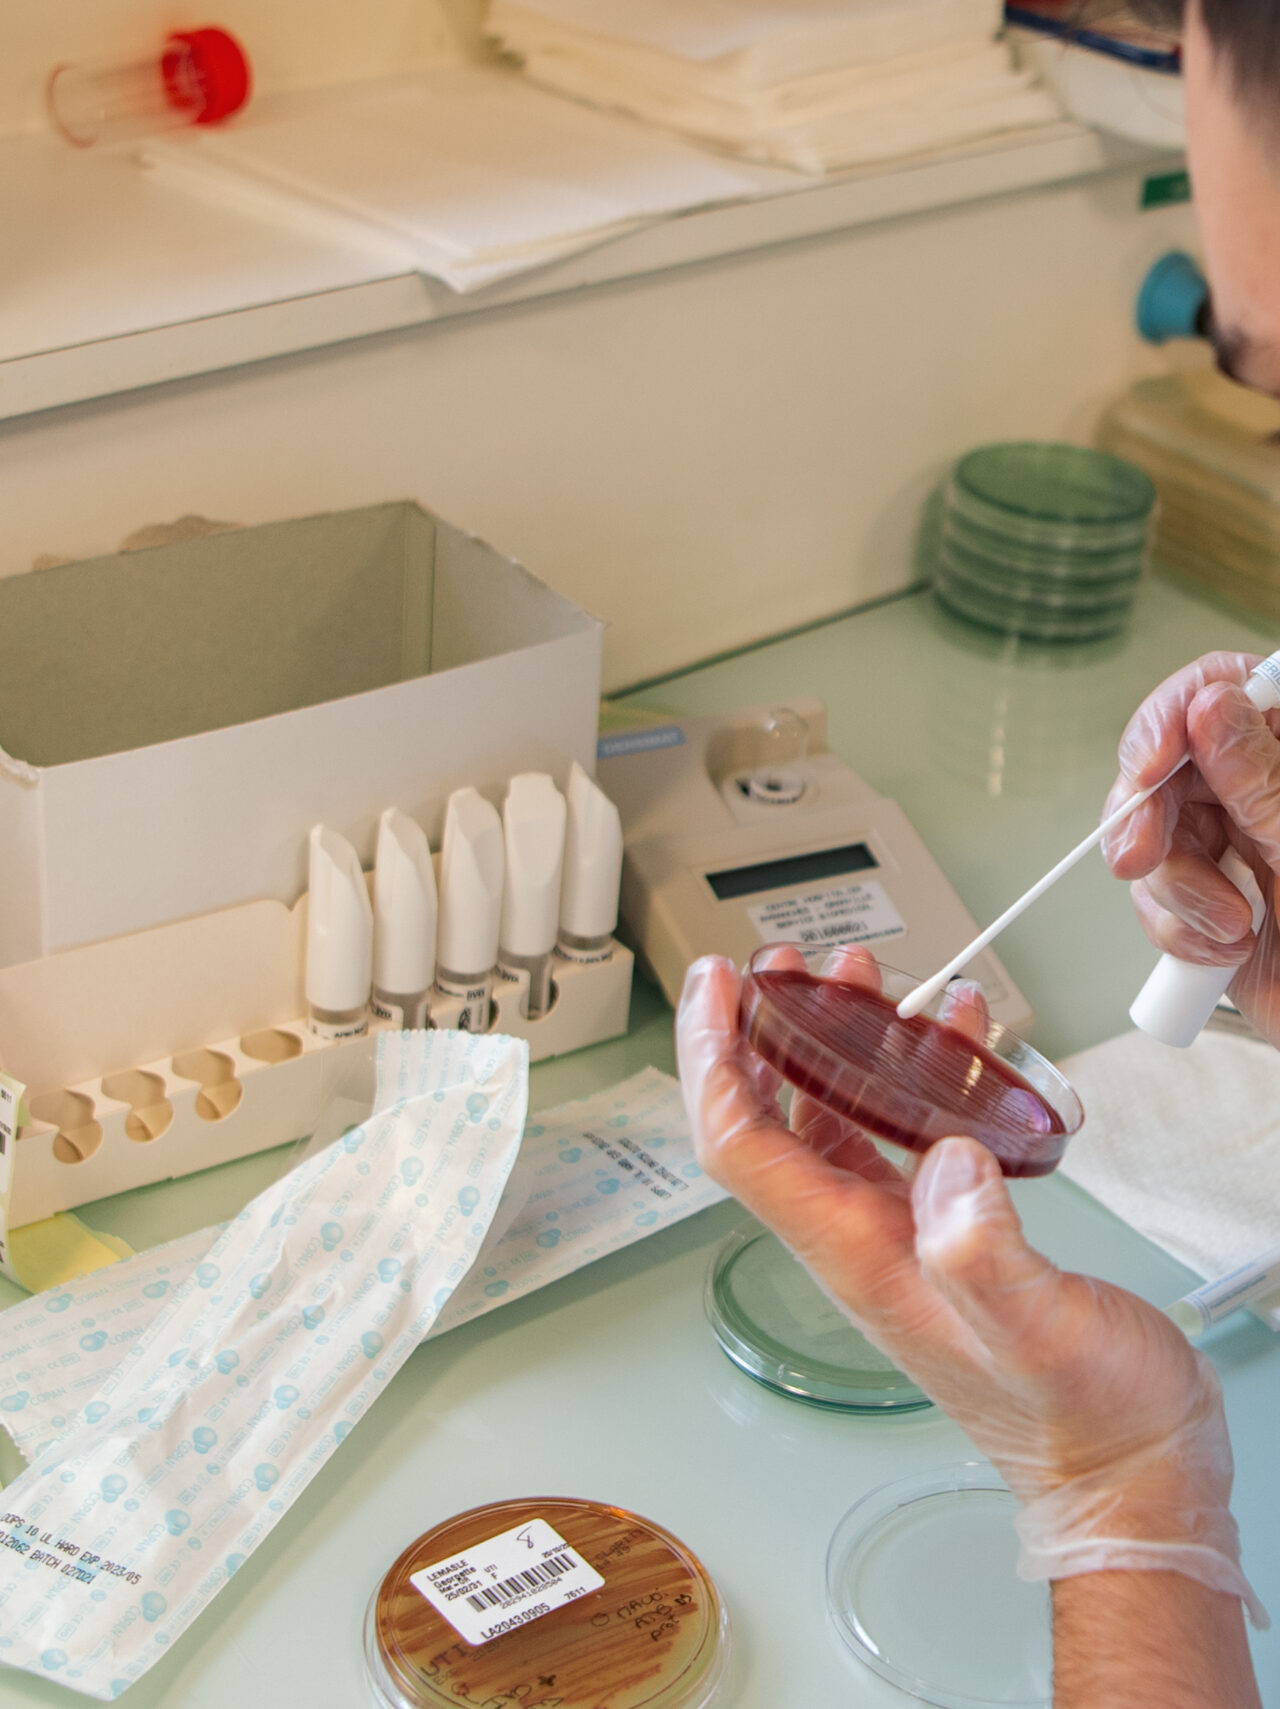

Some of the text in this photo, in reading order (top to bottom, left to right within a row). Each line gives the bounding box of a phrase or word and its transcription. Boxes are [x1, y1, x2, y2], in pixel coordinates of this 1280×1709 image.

[25, 1525, 40, 1537] 10
[54, 1539, 81, 1556] HARD
[29, 1549, 63, 1569] BATCH
[426, 1559, 469, 1582] LEMASLE
[564, 1586, 587, 1600] 7611
[420, 1643, 468, 1677] UTI
